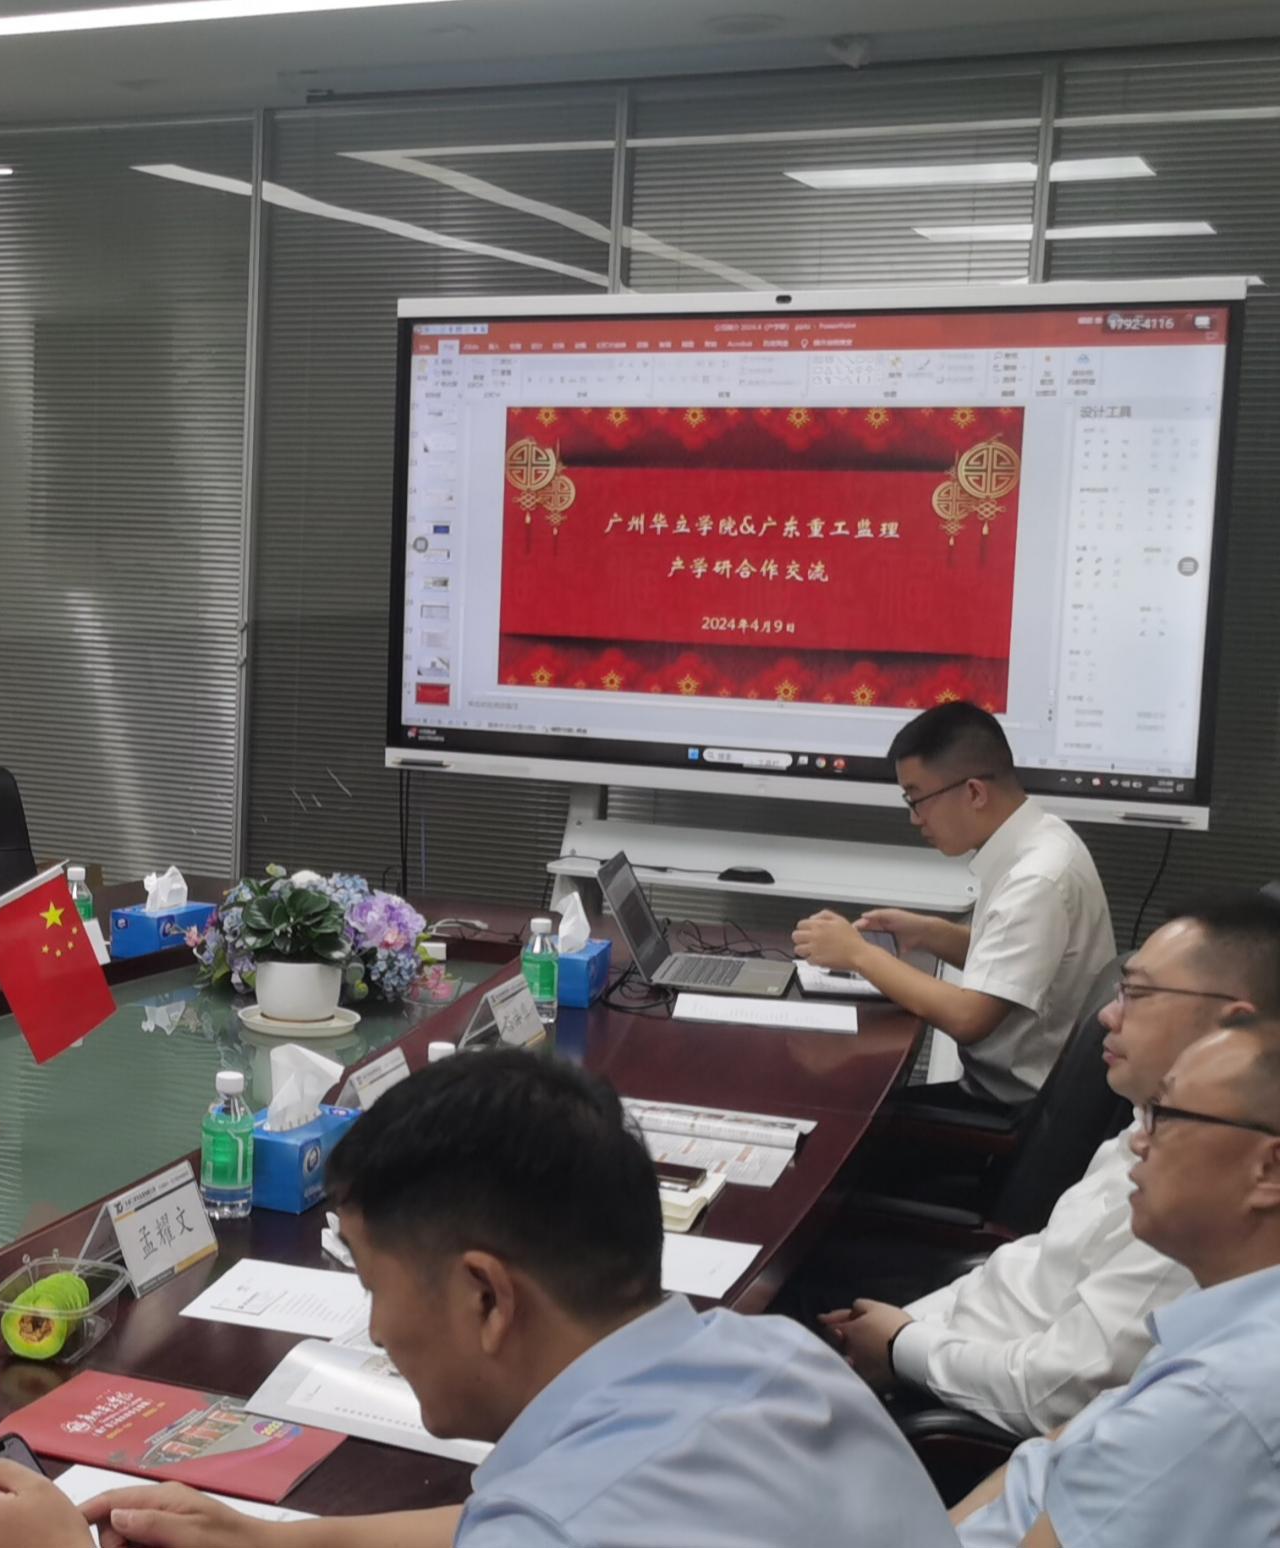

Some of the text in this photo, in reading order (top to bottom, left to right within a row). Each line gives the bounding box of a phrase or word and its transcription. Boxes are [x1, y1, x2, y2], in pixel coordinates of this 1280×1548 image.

[604, 512, 901, 539] 广州华立学院&广东重工监理
[667, 556, 829, 583] 产学研合作交流
[701, 616, 796, 634] 2024年4月9日
